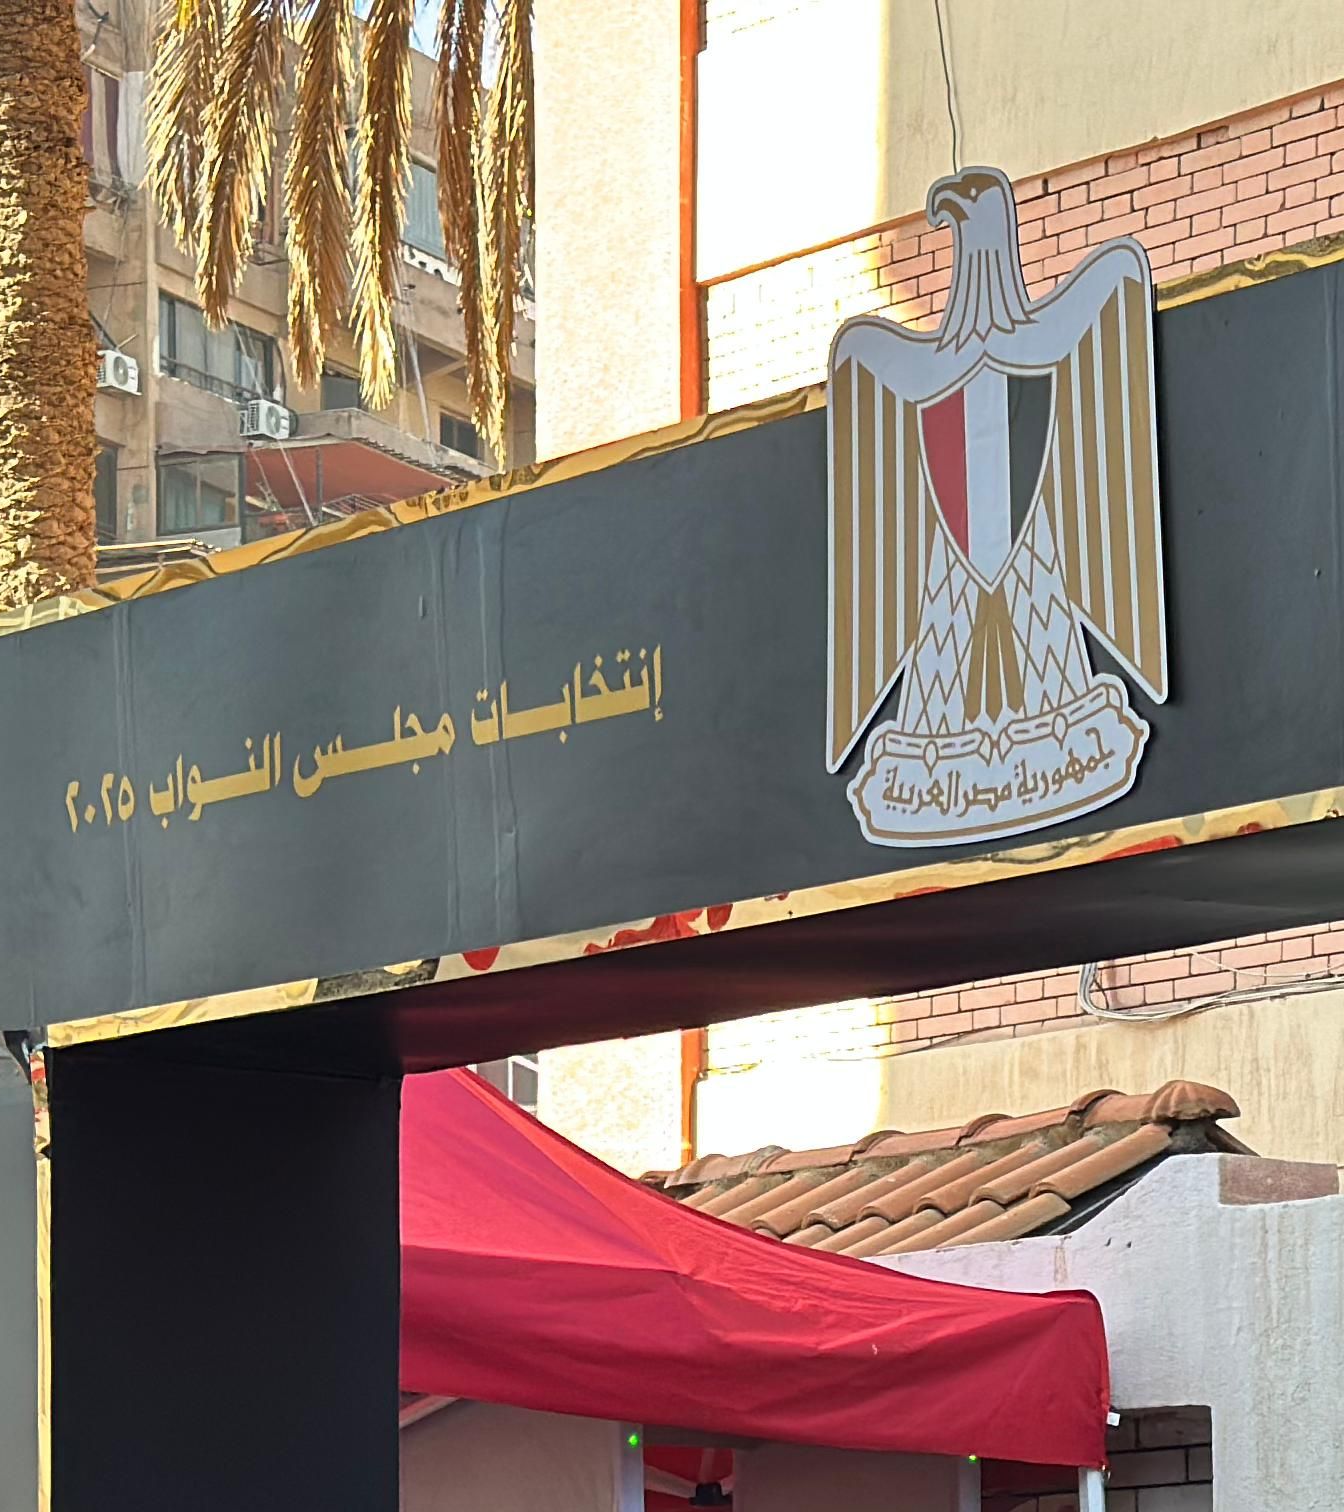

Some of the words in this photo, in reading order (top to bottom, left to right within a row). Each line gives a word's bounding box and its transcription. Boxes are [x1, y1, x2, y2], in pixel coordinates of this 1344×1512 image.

[470, 643, 664, 745] إنتخابات
[149, 730, 282, 829] النواب
[292, 705, 456, 797] مجلس
[882, 765, 961, 816] العربية
[65, 770, 135, 833] ٢٠٢٥
